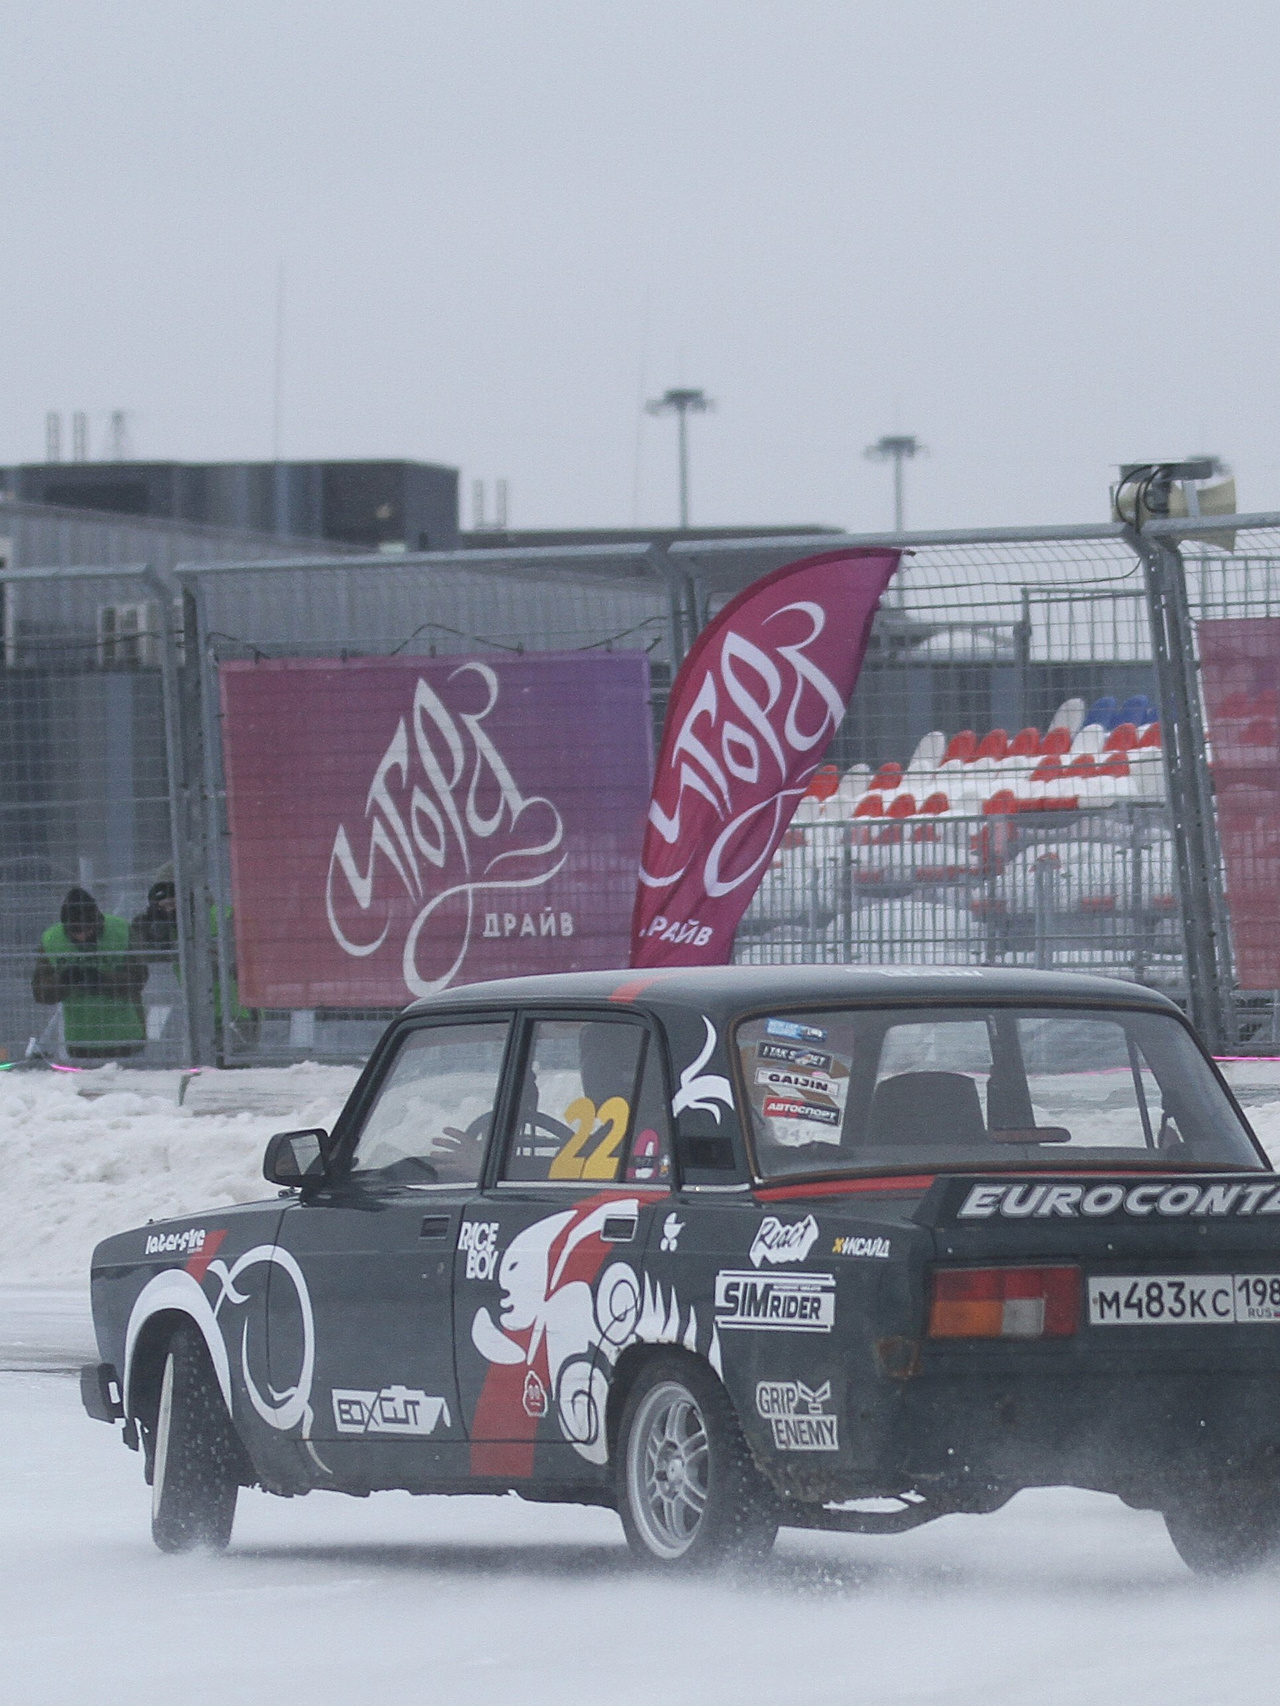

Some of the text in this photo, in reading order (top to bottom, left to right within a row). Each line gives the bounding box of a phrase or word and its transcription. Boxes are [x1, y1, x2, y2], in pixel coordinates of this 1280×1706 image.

[482, 906, 574, 938] ДРАЙВ
[639, 915, 713, 947] РАЙВ
[767, 1102, 837, 1119] АВТОСПОРТ
[547, 1096, 631, 1180] 22
[465, 1250, 499, 1281] BOY
[1248, 1307, 1272, 1318] RUS
[758, 1385, 797, 1415] GRIP
[775, 1420, 837, 1446] ENEMY
